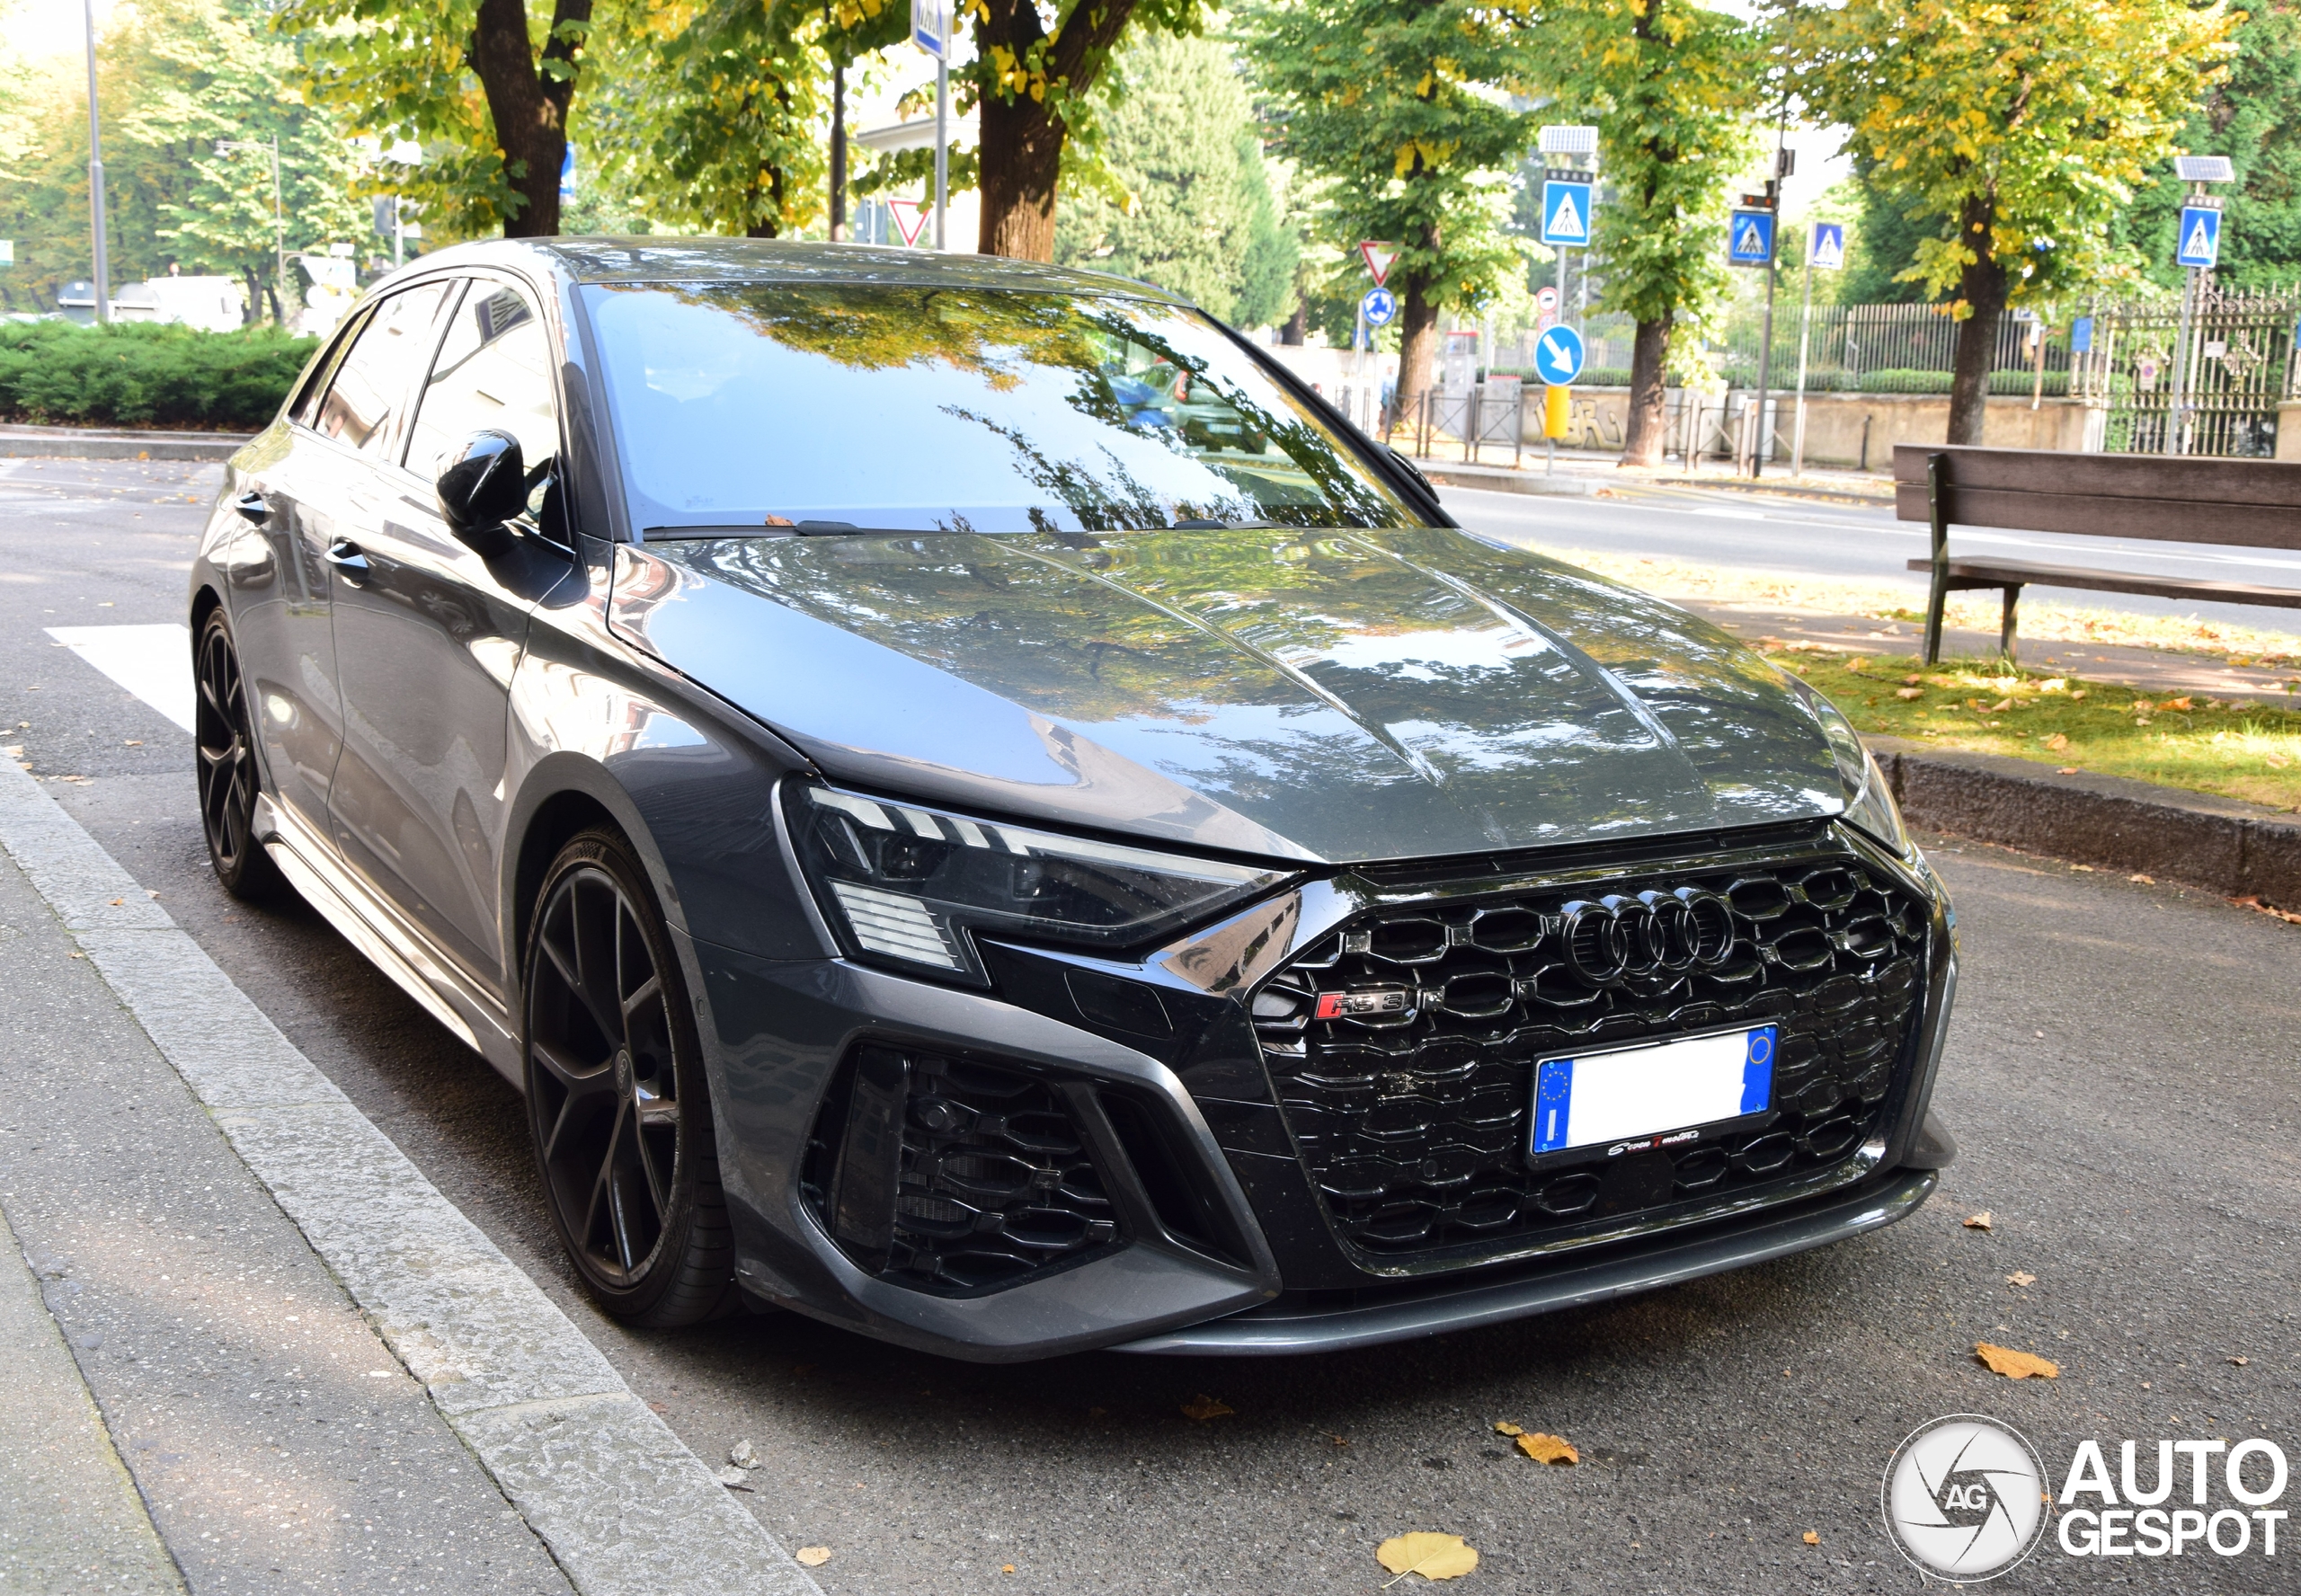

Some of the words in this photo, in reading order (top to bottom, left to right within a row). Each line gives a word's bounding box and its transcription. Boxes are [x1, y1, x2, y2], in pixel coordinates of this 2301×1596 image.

[1330, 995, 1374, 1014] RS
[1382, 994, 1404, 1009] 3
[1547, 1109, 1557, 1141] I
[1608, 1141, 1651, 1156] Seven
[1653, 1136, 1663, 1148] 7
[598, 1292, 635, 1311] KUMHO
